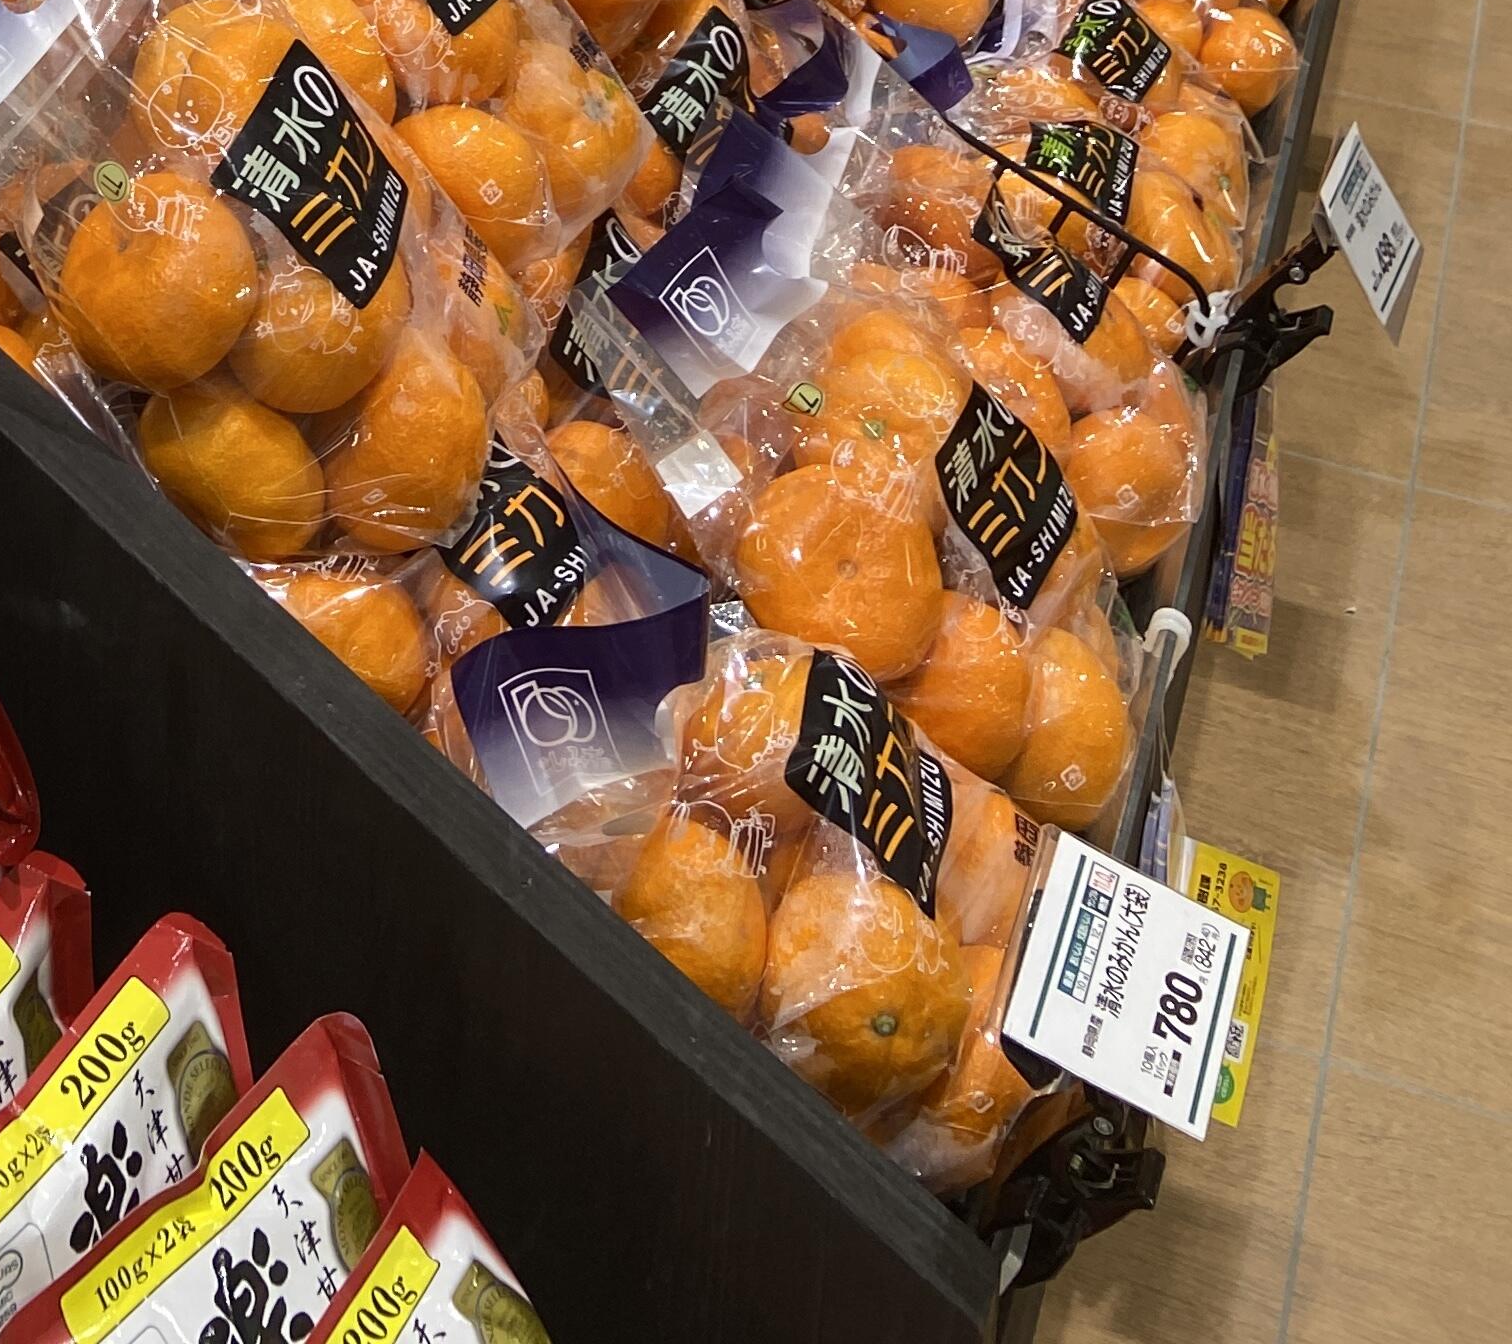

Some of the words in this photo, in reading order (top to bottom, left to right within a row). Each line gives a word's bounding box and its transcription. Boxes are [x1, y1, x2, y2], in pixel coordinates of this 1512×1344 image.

[232, 65, 340, 213] 清水の
[651, 25, 743, 144] 清水の
[100, 173, 123, 196] LL
[292, 119, 376, 257] ミカン
[347, 169, 402, 293] JA-SHIMIZU
[968, 427, 1049, 558] ミカン
[1007, 477, 1078, 601] JA-SHIMIZ
[807, 655, 878, 814] 清水の
[60, 1020, 146, 1109] 200g
[208, 1135, 283, 1212] 200g
